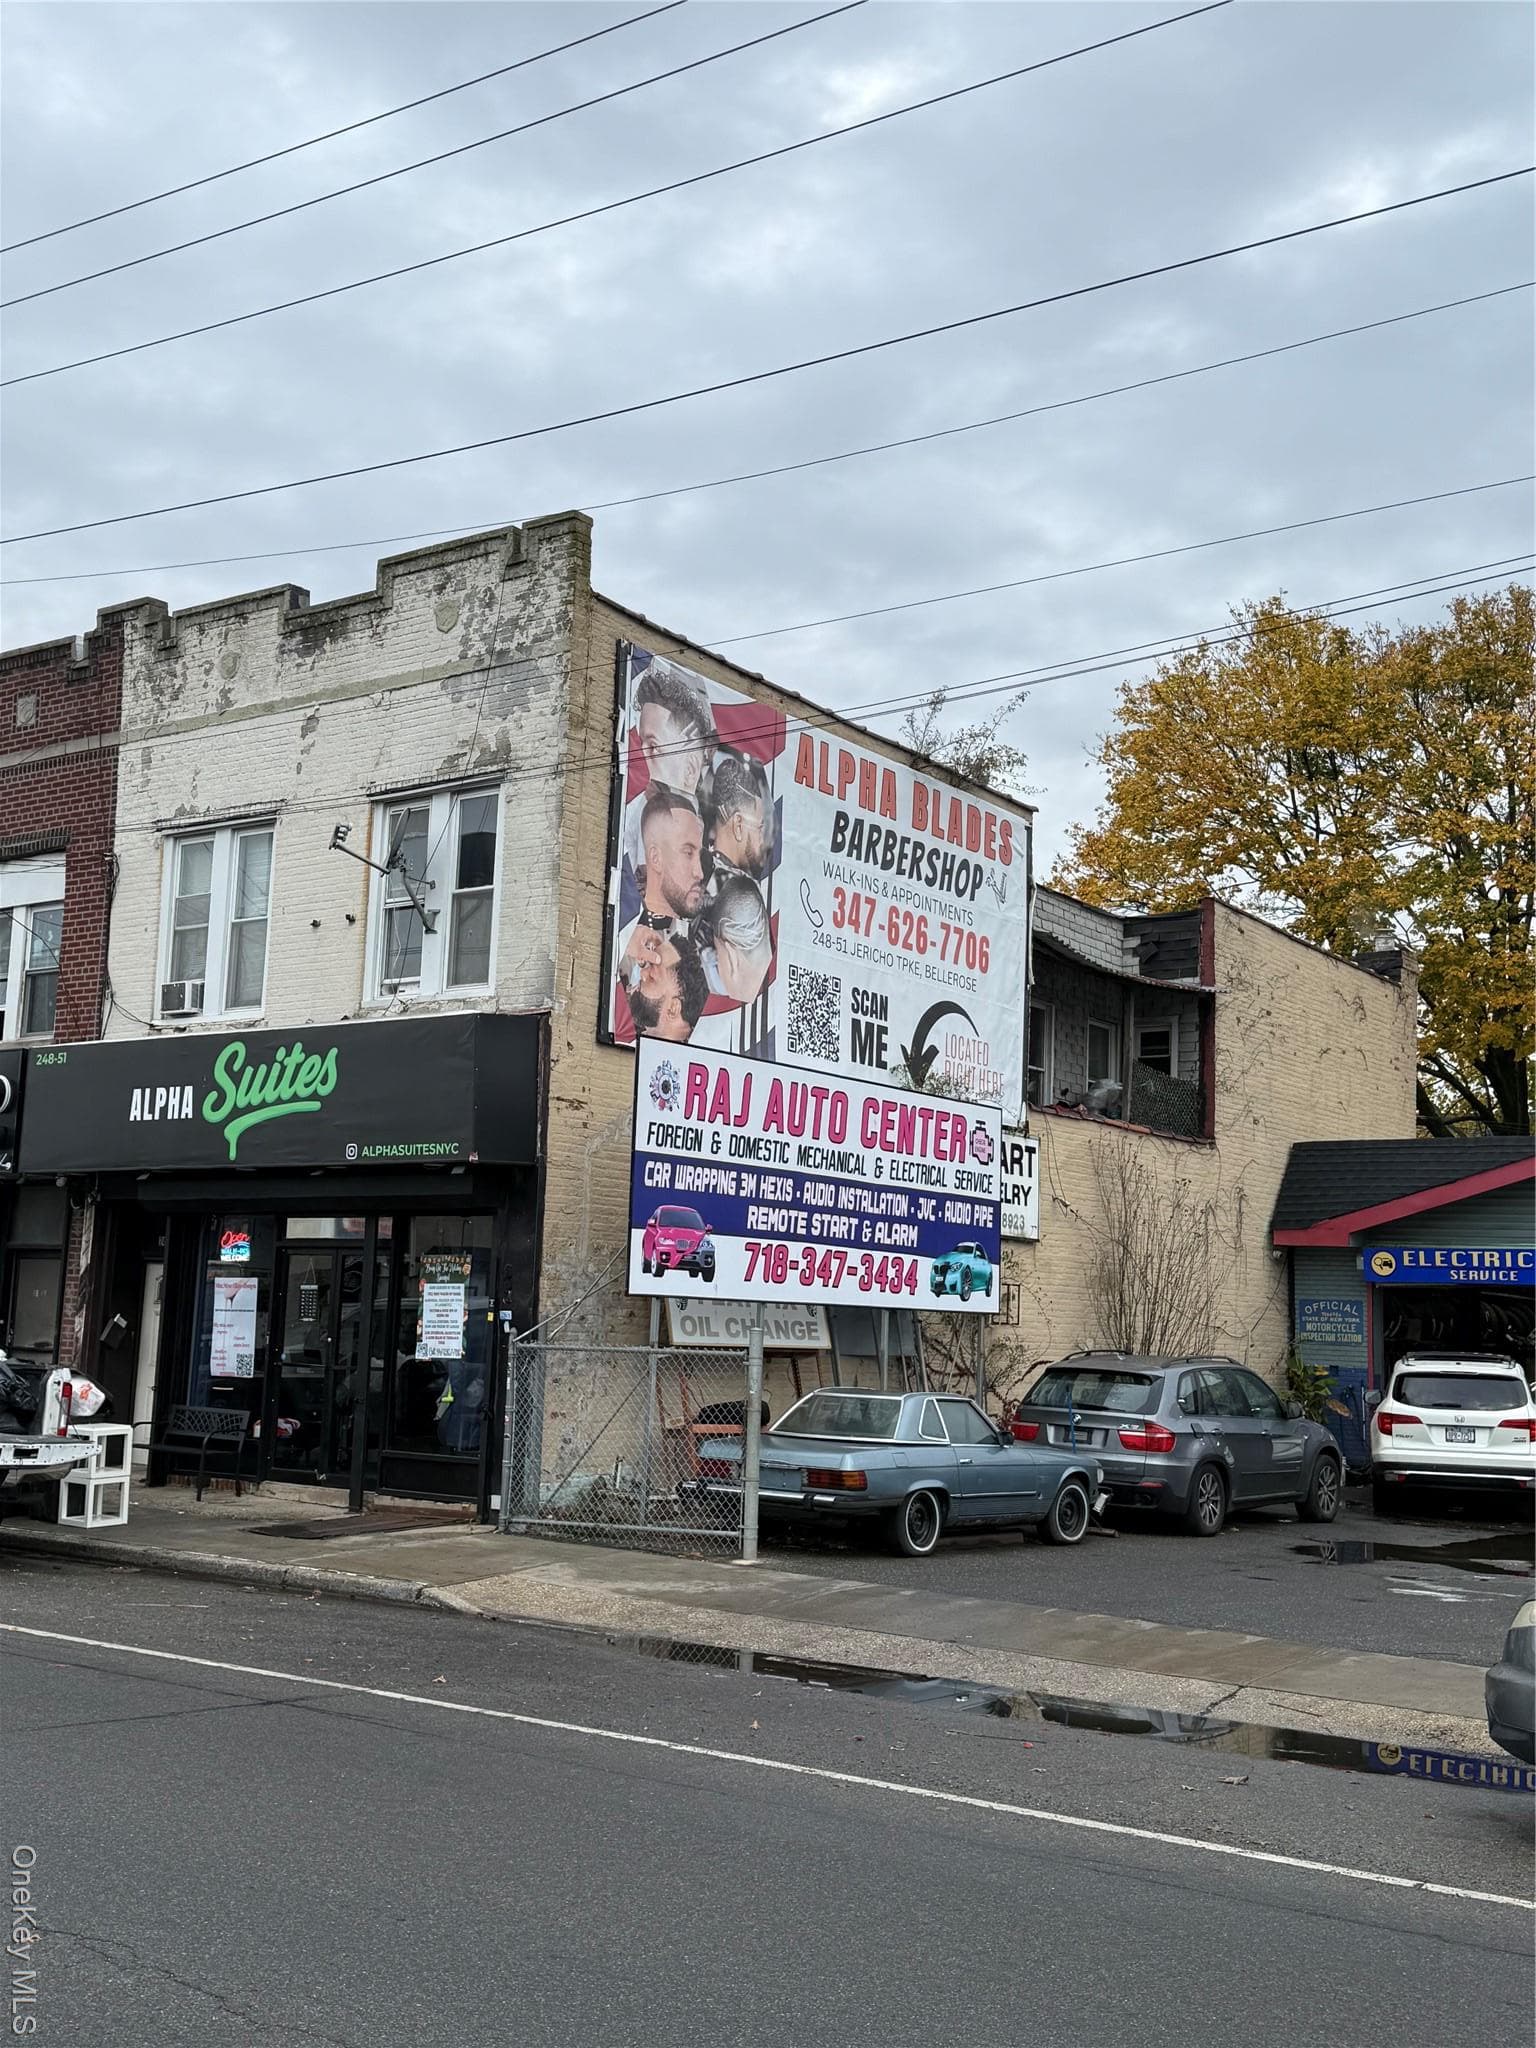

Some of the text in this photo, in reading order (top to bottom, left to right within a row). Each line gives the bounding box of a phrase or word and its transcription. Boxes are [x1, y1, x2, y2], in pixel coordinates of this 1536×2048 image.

[794, 732, 1013, 866] ALPHA BLADES
[830, 810, 984, 900] BARBERSHOP
[822, 860, 974, 927] WALK-INS & APPOINTMENTS
[832, 886, 990, 974] 347-626-7706
[812, 930, 977, 993] 248-51 JERICHO TPKE, BELLEROSE
[851, 986, 888, 1022] SCAN
[36, 1052, 67, 1065] 248-51
[851, 1018, 888, 1070] ME
[945, 1032, 989, 1066] LOCATED
[129, 1041, 338, 1123] ALPHA Suites
[684, 1062, 968, 1164] RAJ AUTO CENTER
[361, 1143, 459, 1157] ALPHASUITESNYC
[646, 1121, 993, 1194] FOREIGN & DOMESTIC MECHANICAL & ELECTRICAL SERVICE
[644, 1160, 993, 1228] CAR WRAPPING 3M HEXIS AUDIO INSTALLATION JVC AUDIO PIPE
[221, 1231, 250, 1247] Open
[747, 1205, 918, 1247] REMOTE START & ALARM
[744, 1242, 918, 1295] 718-347-3434
[1402, 1250, 1534, 1268] ELECTRIC
[1450, 1270, 1518, 1281] SERVICE
[679, 1315, 820, 1341] OIL CHANGE
[1305, 1301, 1358, 1316] OFFICIAL
[1306, 1322, 1357, 1333] MOTORCYCLE
[1301, 1331, 1362, 1343] INSPECTION STATION
